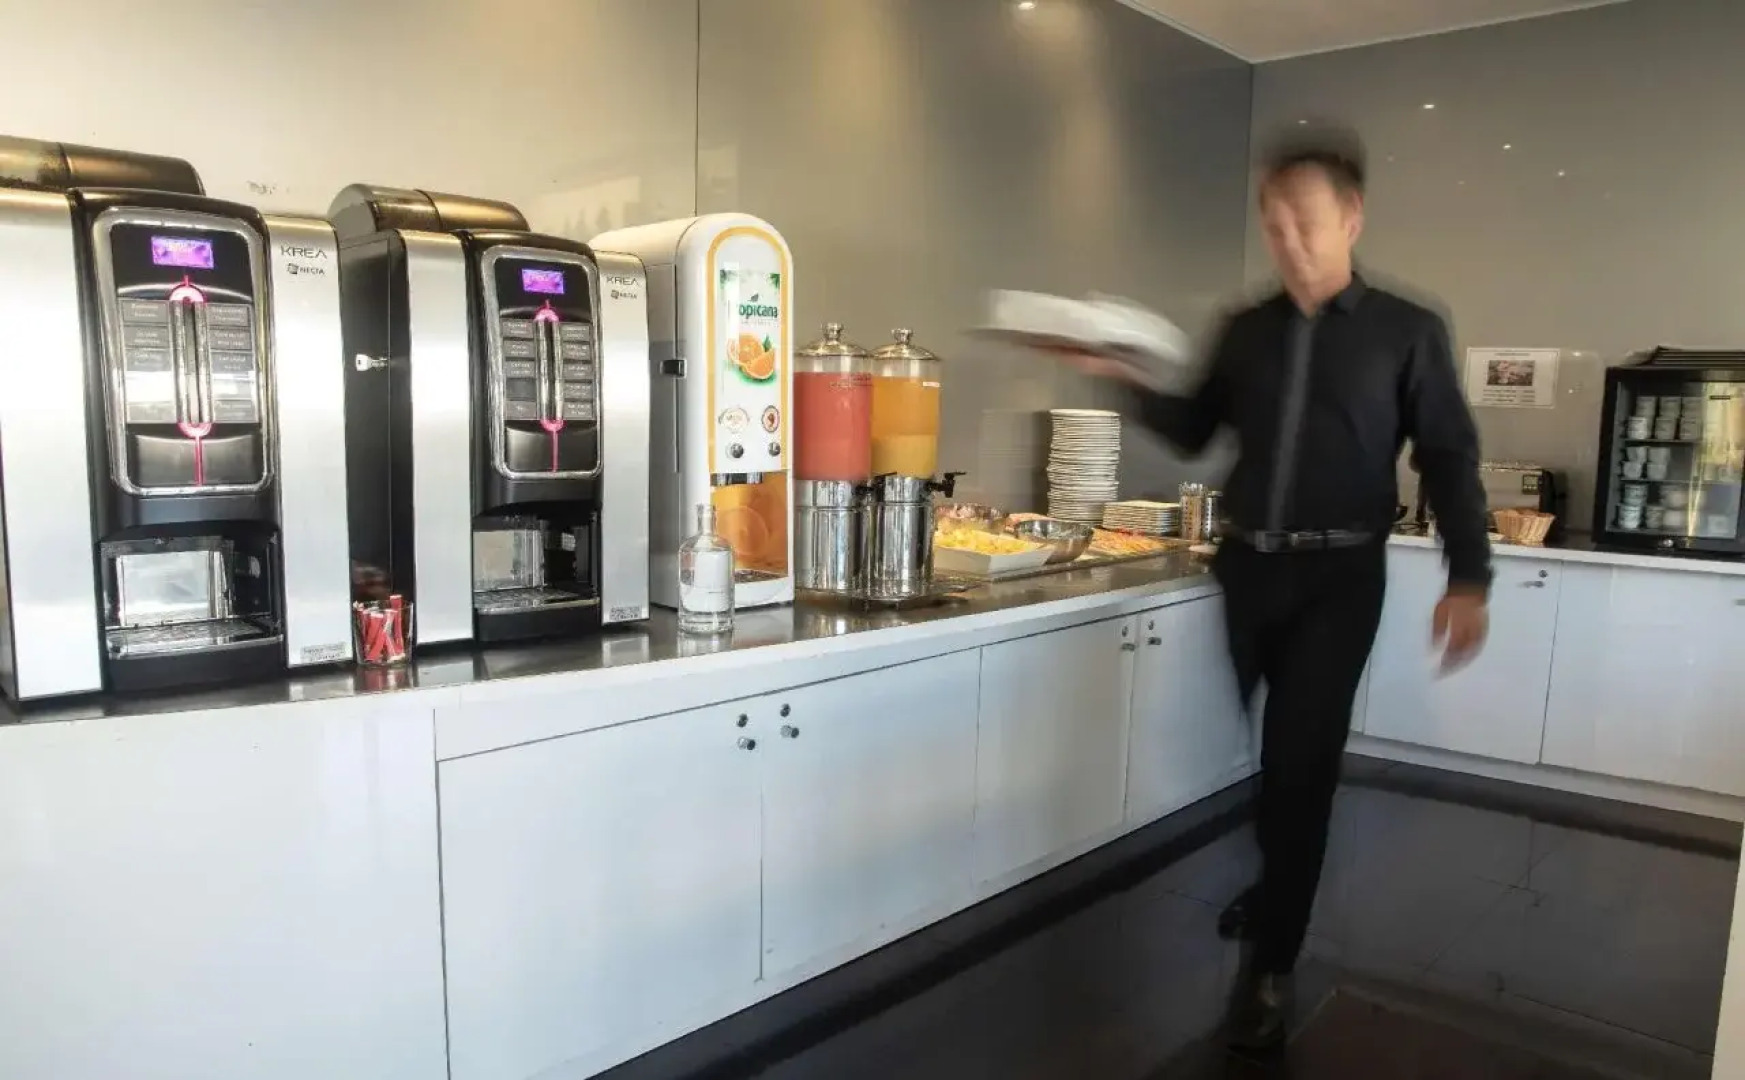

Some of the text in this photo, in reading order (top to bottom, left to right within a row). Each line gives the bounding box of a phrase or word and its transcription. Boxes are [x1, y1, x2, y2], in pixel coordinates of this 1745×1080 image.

[280, 245, 327, 260] KREA
[606, 276, 640, 287] KREA
[737, 303, 778, 319] opicana
